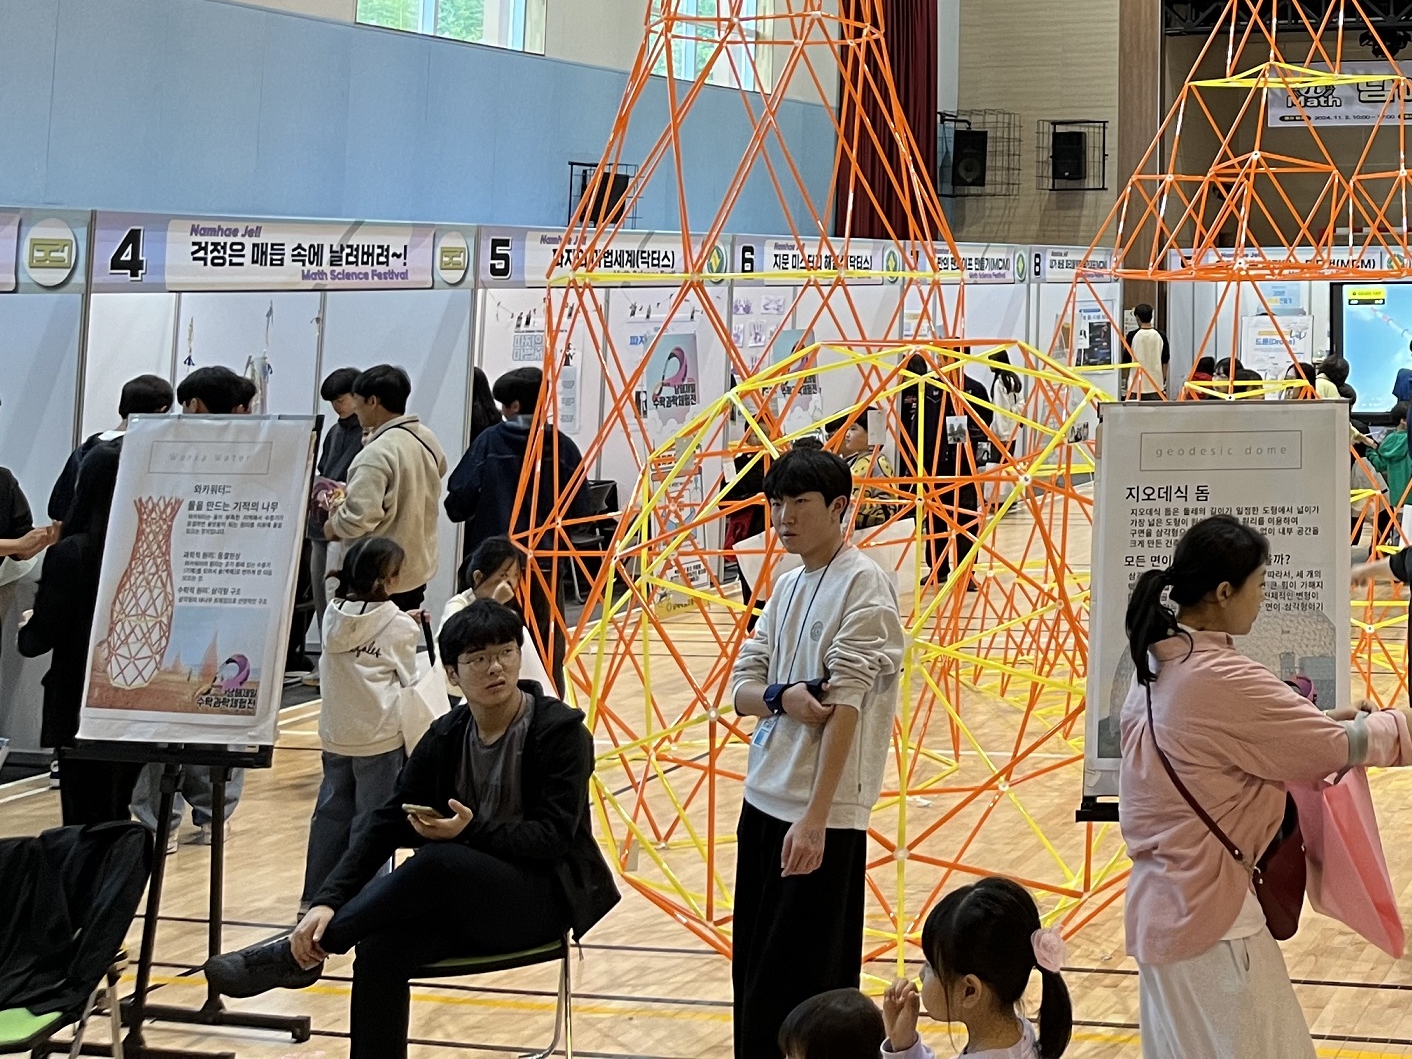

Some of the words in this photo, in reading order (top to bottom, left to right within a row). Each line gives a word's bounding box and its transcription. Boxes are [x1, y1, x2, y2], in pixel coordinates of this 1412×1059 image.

[1287, 93, 1342, 108] Math
[190, 225, 239, 238] Namhae
[241, 226, 262, 238] Jell
[110, 226, 147, 281] 4
[190, 241, 246, 267] 걱정은
[251, 243, 287, 268] 매듭
[291, 243, 324, 268] 속에
[329, 244, 408, 268] 날려버려~!
[489, 237, 513, 280] 5
[741, 245, 756, 278] 6
[772, 253, 789, 271] 지문
[1034, 253, 1042, 277] 8
[301, 269, 327, 281] Math
[329, 269, 369, 281] Science
[371, 270, 409, 281] Festival
[1155, 445, 1233, 457] geodesic
[1245, 445, 1288, 455] dome
[1125, 485, 1188, 502] 지오데식
[1194, 485, 1210, 502] 돔
[206, 501, 230, 512] 만드는
[232, 501, 259, 512] 기적의
[261, 502, 279, 512] 나무
[1130, 507, 1161, 517] 지오데식
[1164, 507, 1180, 516] 돔은
[1183, 506, 1206, 516] 둘레의
[1210, 506, 1233, 516] 길이가
[1236, 506, 1259, 516] 일정한
[1262, 505, 1293, 515] 도형에서
[1296, 505, 1320, 515] 넓이가
[1130, 518, 1145, 527] 가장
[1147, 518, 1163, 527] 넓은
[1165, 518, 1188, 527] 도형이
[1267, 517, 1298, 526] 이용하여
[1130, 529, 1152, 538] 구면을
[1155, 528, 1186, 538] 삼각형으
[1278, 527, 1293, 536] 내부
[1296, 526, 1319, 536] 공간을
[1129, 539, 1145, 548] 크게
[1147, 539, 1163, 548] 만든
[1124, 554, 1146, 567] 모든
[1150, 554, 1172, 566] 면이
[1267, 570, 1293, 579] 따라서,
[1296, 570, 1303, 579] 세
[1306, 570, 1321, 579] 개의
[1281, 581, 1297, 590] 힘이
[1296, 591, 1319, 601] 변형이
[1265, 603, 1281, 612] 면이
[1284, 602, 1324, 612] 삼각형이기
